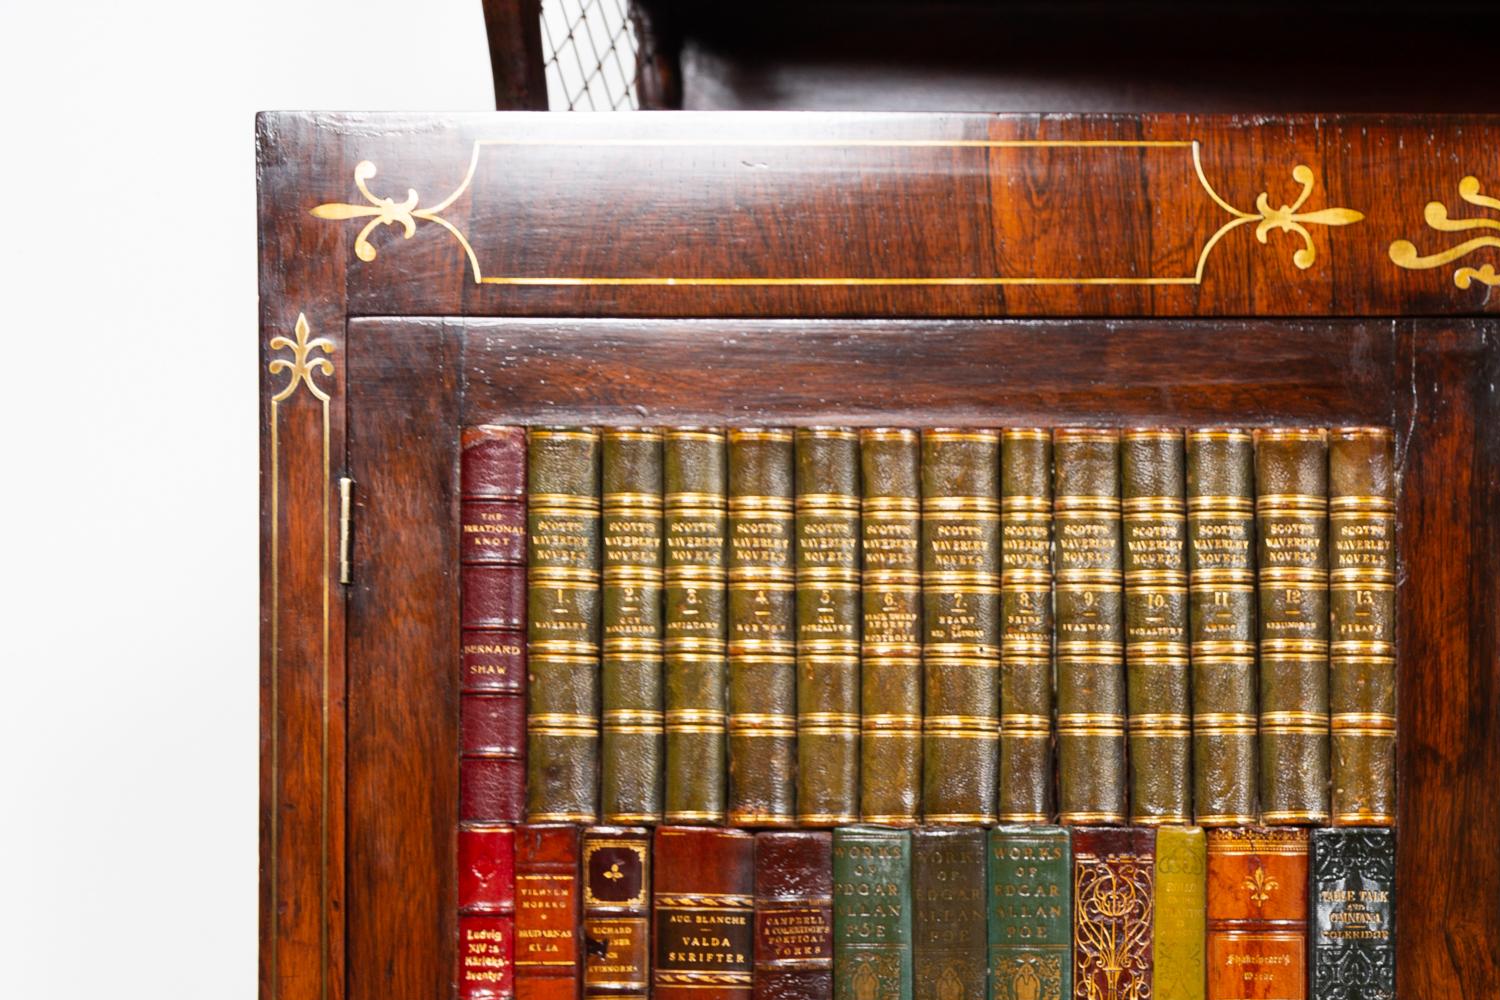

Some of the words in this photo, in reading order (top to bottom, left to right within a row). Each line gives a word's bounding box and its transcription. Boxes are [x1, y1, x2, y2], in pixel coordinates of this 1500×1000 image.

[481, 513, 502, 521] THE
[474, 538, 510, 546] KNOT
[1193, 540, 1249, 550] WAVERLEY
[1265, 538, 1321, 548] WAVERLEY
[1336, 540, 1391, 551] WAVERLEY
[1270, 552, 1318, 562] NOVELS
[1339, 554, 1386, 564] NOVELS
[464, 645, 521, 655] BERNARD
[470, 665, 507, 674] SHAW
[995, 847, 1062, 862] WORKS
[1016, 867, 1038, 878] OF
[994, 885, 1061, 898] EDGAR
[1359, 891, 1390, 903] TALK
[996, 905, 1062, 919] ALLAN
[696, 916, 746, 925] BLANCHE
[766, 917, 825, 926] CAMPBELL
[467, 929, 502, 942] Ludvig
[1007, 926, 1048, 938] POE
[682, 936, 731, 947] VALDA
[668, 952, 745, 964] SKRIFTER
